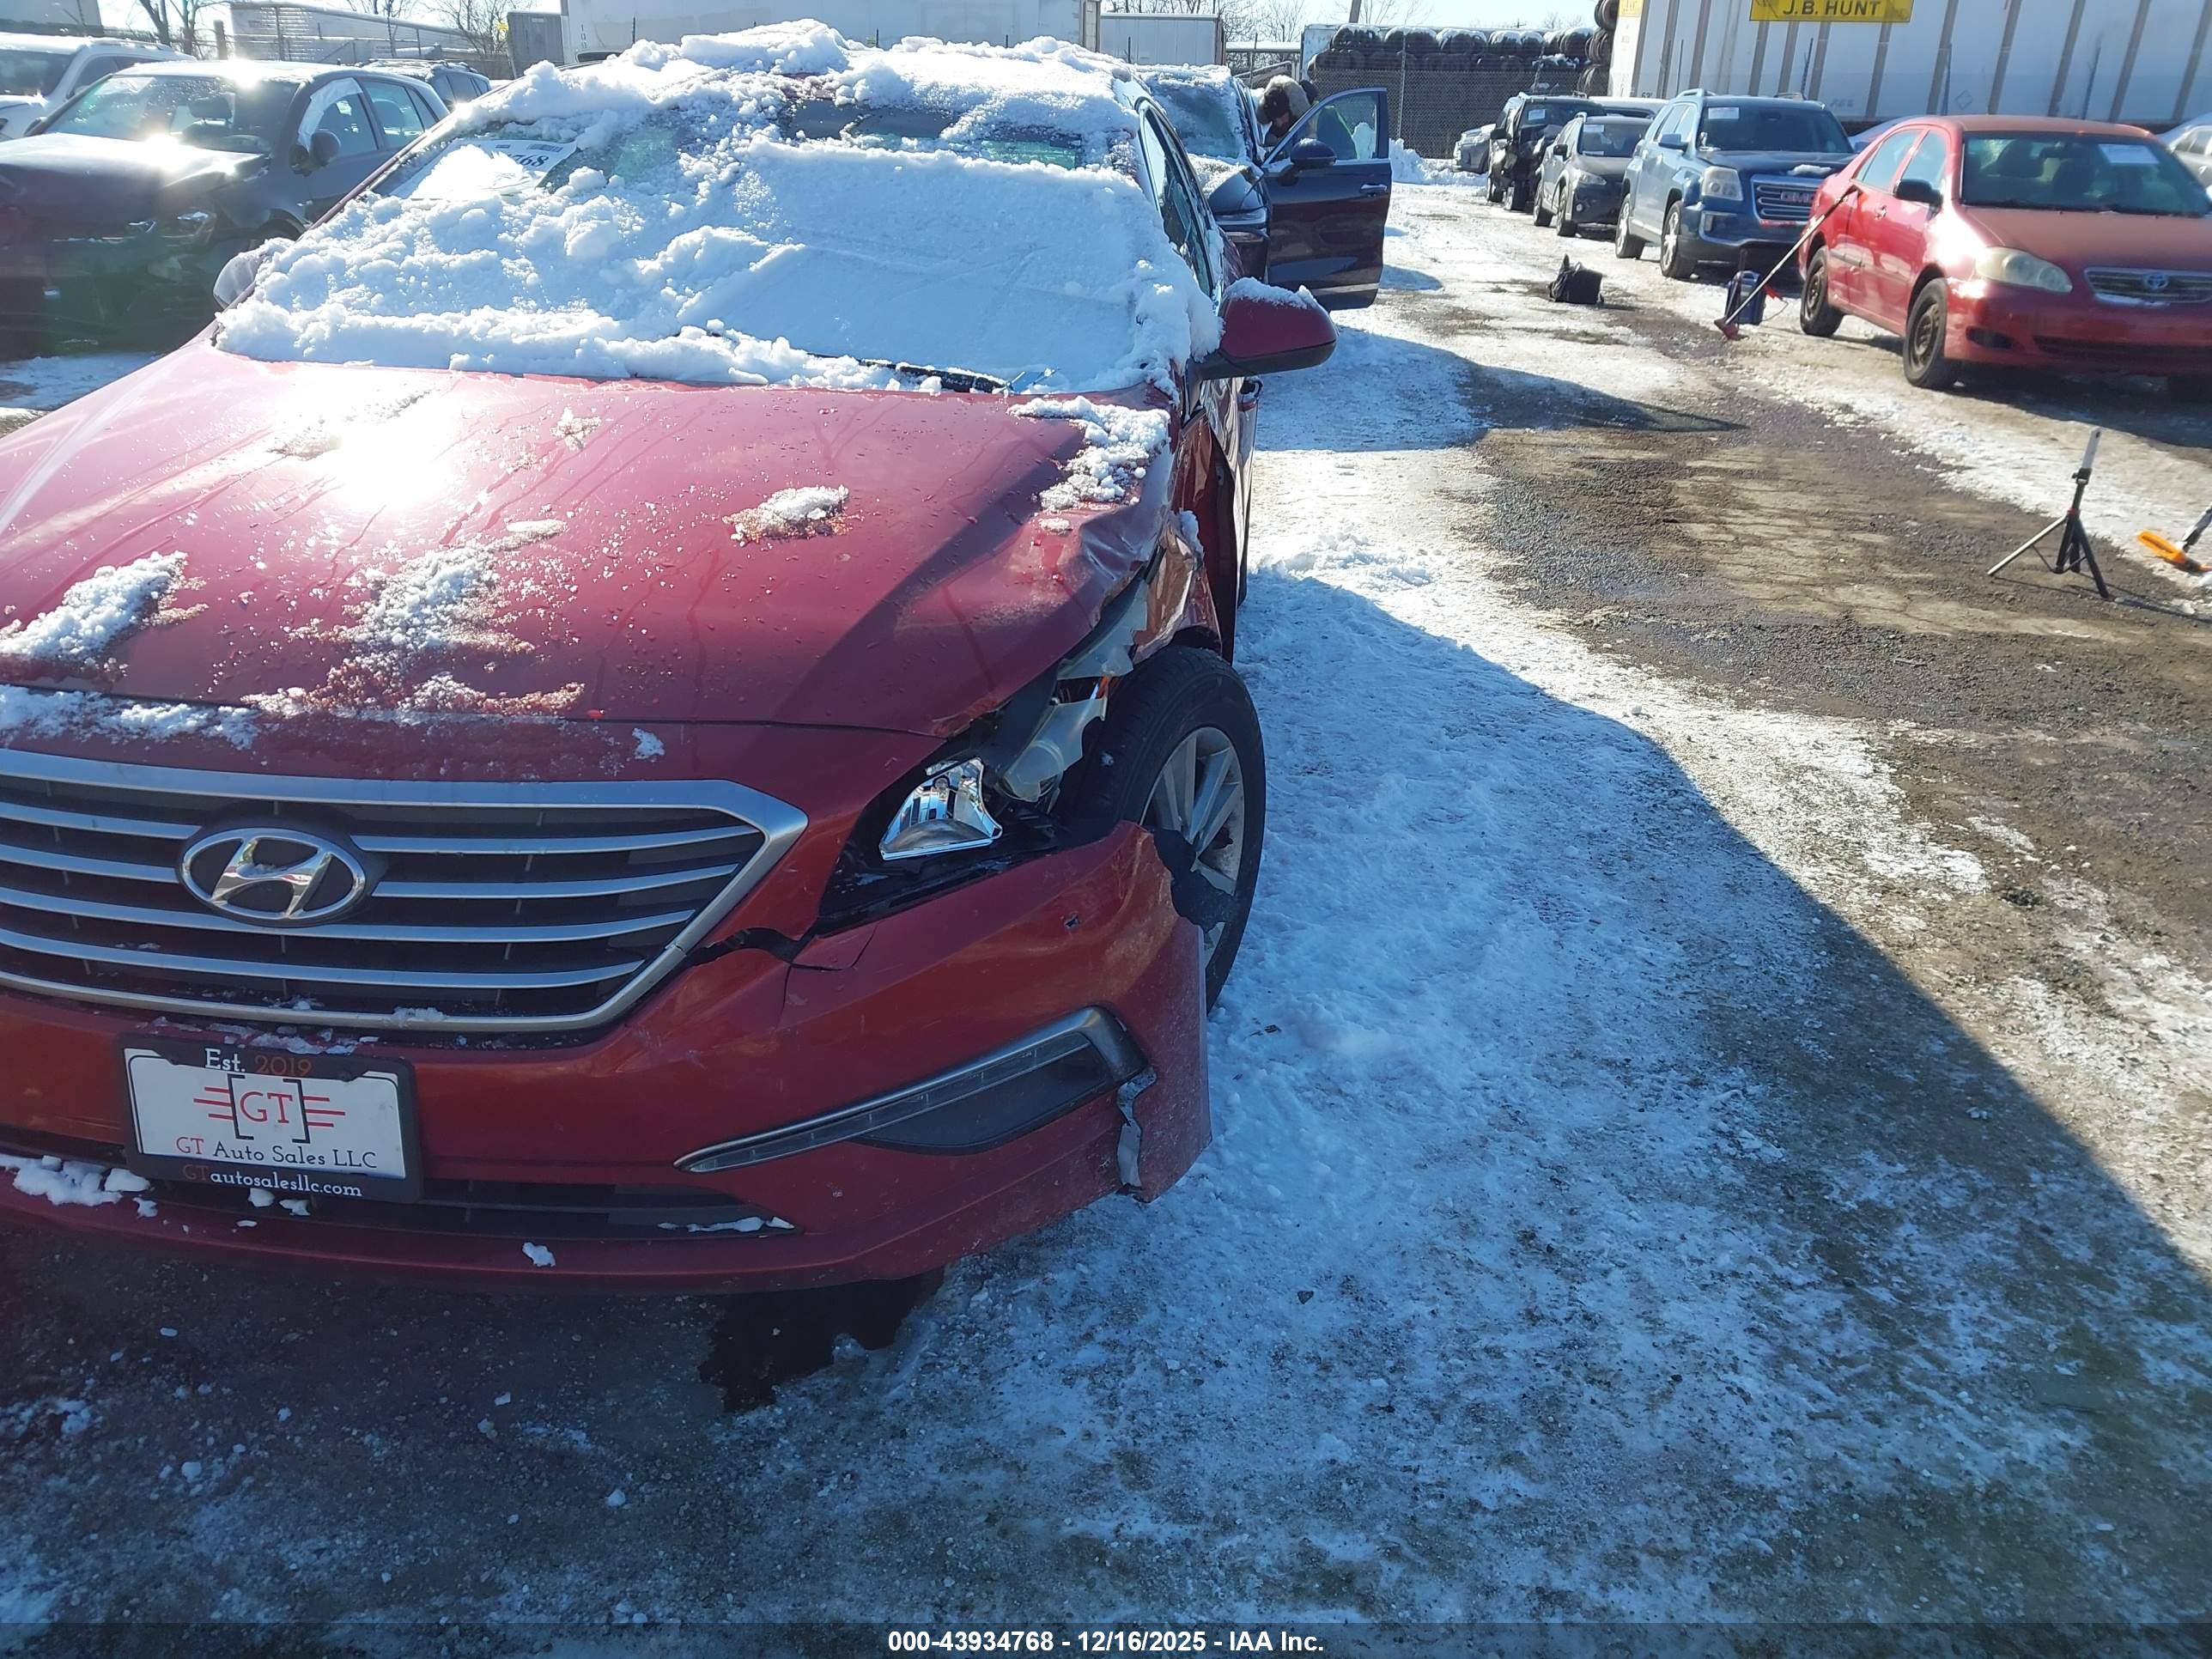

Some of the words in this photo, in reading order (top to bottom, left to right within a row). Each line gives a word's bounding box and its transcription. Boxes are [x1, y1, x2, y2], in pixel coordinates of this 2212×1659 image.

[1825, 0, 1880, 15] HUNT
[508, 155, 549, 167] 768
[1780, 191, 1812, 203] GM
[204, 1048, 246, 1073] Est.
[254, 1054, 313, 1077] 2019
[240, 1091, 293, 1124] GT
[176, 1136, 204, 1155] GT
[213, 1140, 264, 1161] Auto
[272, 1145, 325, 1165] Sales
[332, 1149, 378, 1169] LLC
